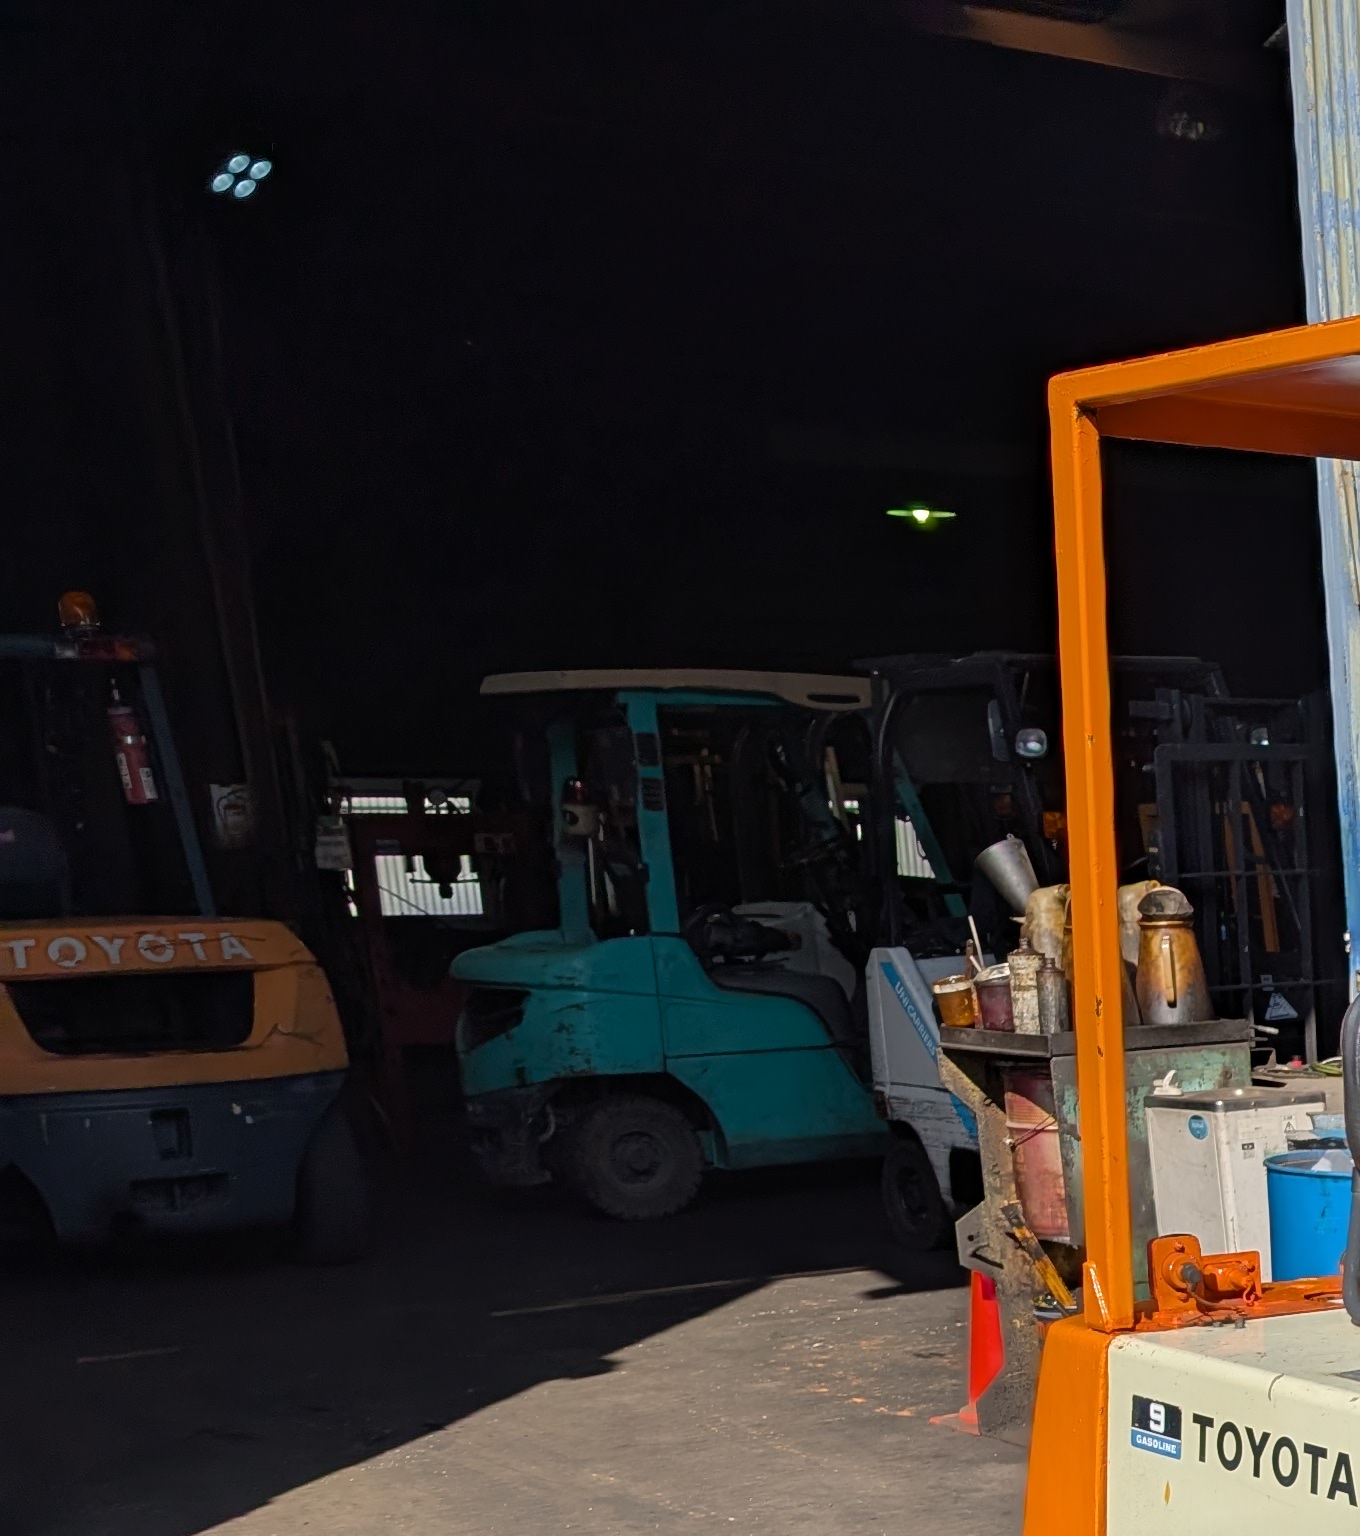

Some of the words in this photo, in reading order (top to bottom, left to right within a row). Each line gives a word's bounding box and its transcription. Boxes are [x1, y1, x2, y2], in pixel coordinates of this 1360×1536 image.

[7, 932, 254, 969] TOYOTA
[894, 980, 936, 1057] UNICARRIERS
[1149, 1402, 1165, 1433] 9
[1135, 1433, 1177, 1455] GASOLINE
[1192, 1412, 1359, 1508] TOYOTA
